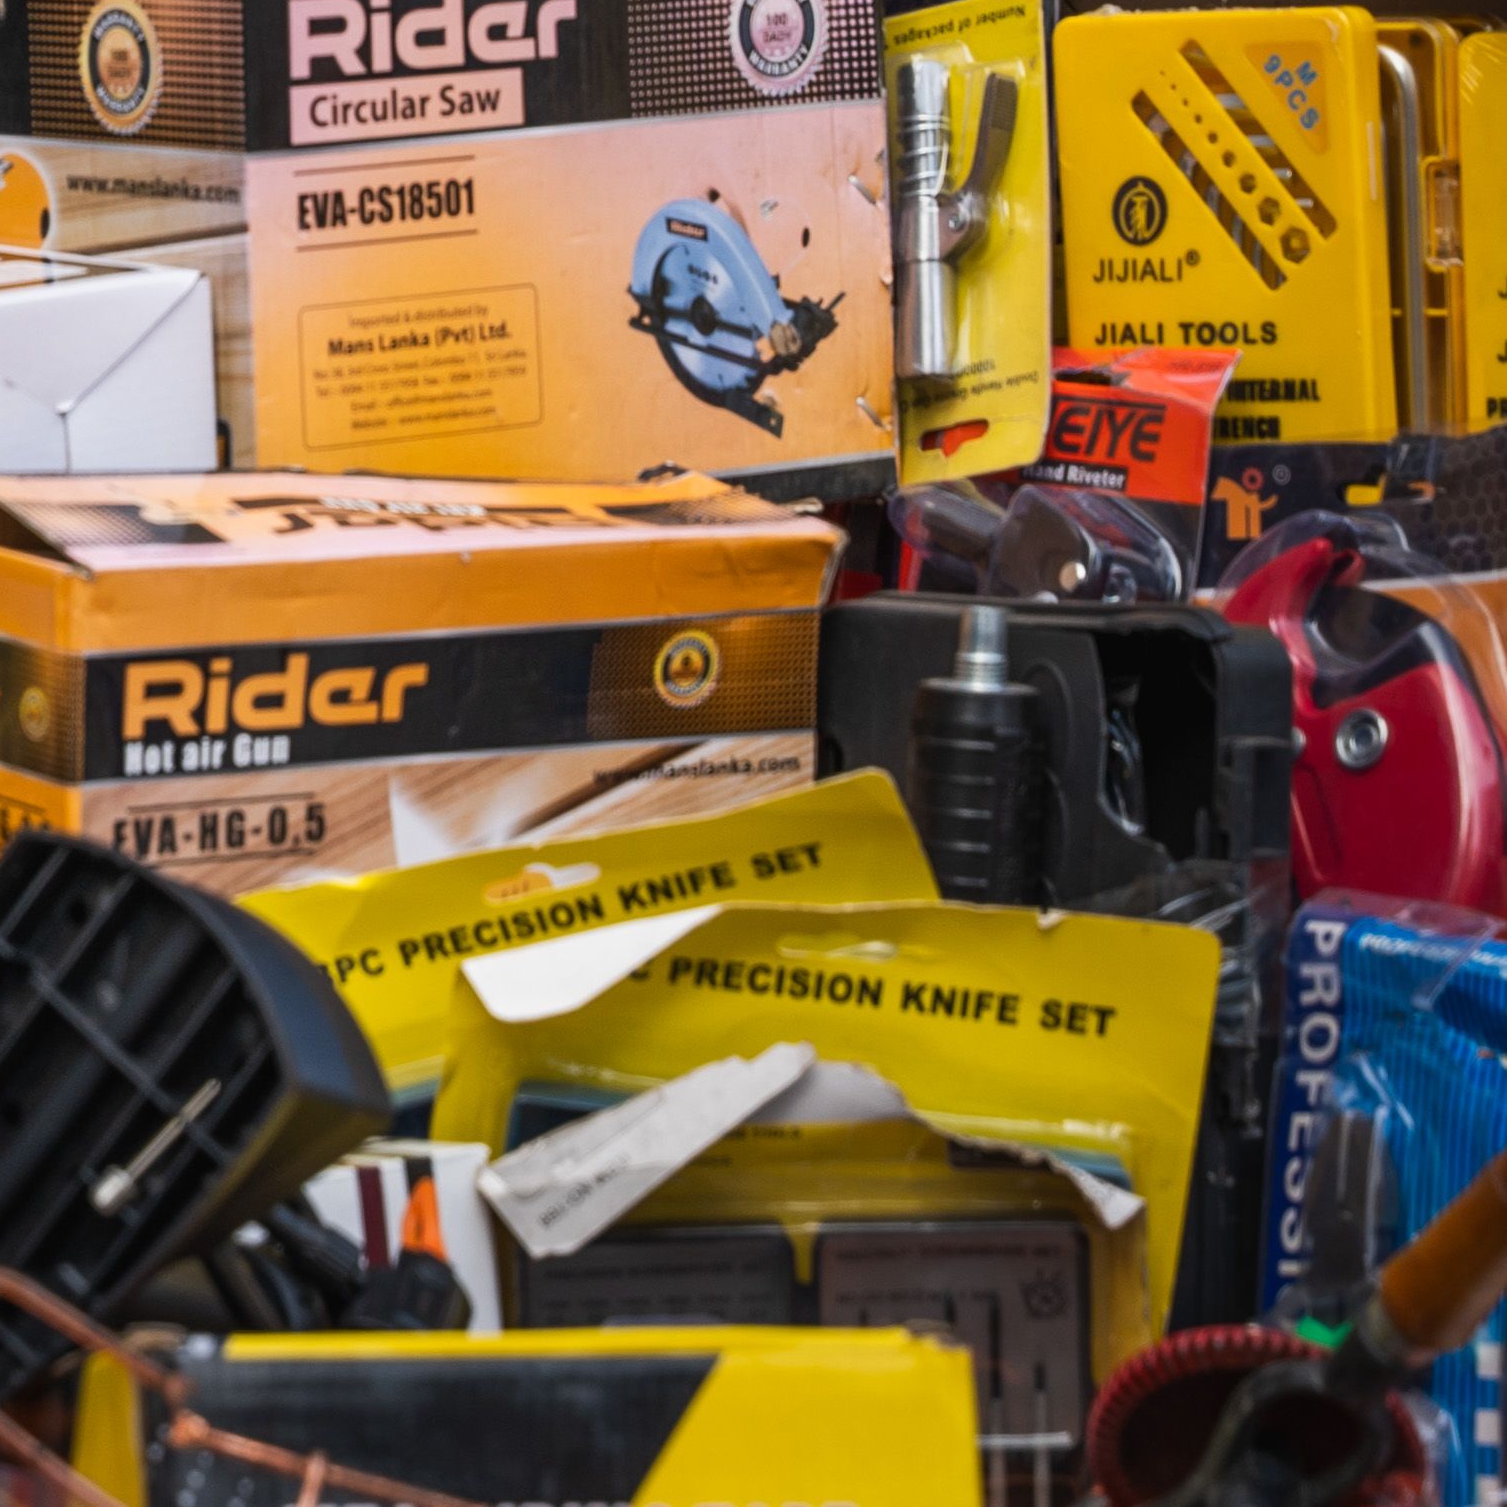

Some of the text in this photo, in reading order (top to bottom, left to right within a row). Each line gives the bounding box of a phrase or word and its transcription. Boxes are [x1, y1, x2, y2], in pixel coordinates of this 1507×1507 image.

[958, 17, 972, 31] of
[975, 5, 1025, 26] Number
[308, 82, 500, 129] Circular Saw
[297, 179, 475, 231] EVA-CS18501
[1093, 258, 1183, 283] JIJIALI
[328, 338, 374, 356] Mans
[378, 332, 429, 352] Lanka
[1095, 321, 1278, 346] JIALI TOOLS
[1066, 465, 1126, 490] Riveter
[122, 652, 429, 741] Rider
[124, 733, 290, 777] Hot air Gun
[397, 843, 823, 969] PRECISION KNIFE SET
[669, 956, 885, 1007] PRECISION
[901, 981, 1020, 1025] KNIFE
[1040, 999, 1117, 1036] SET
